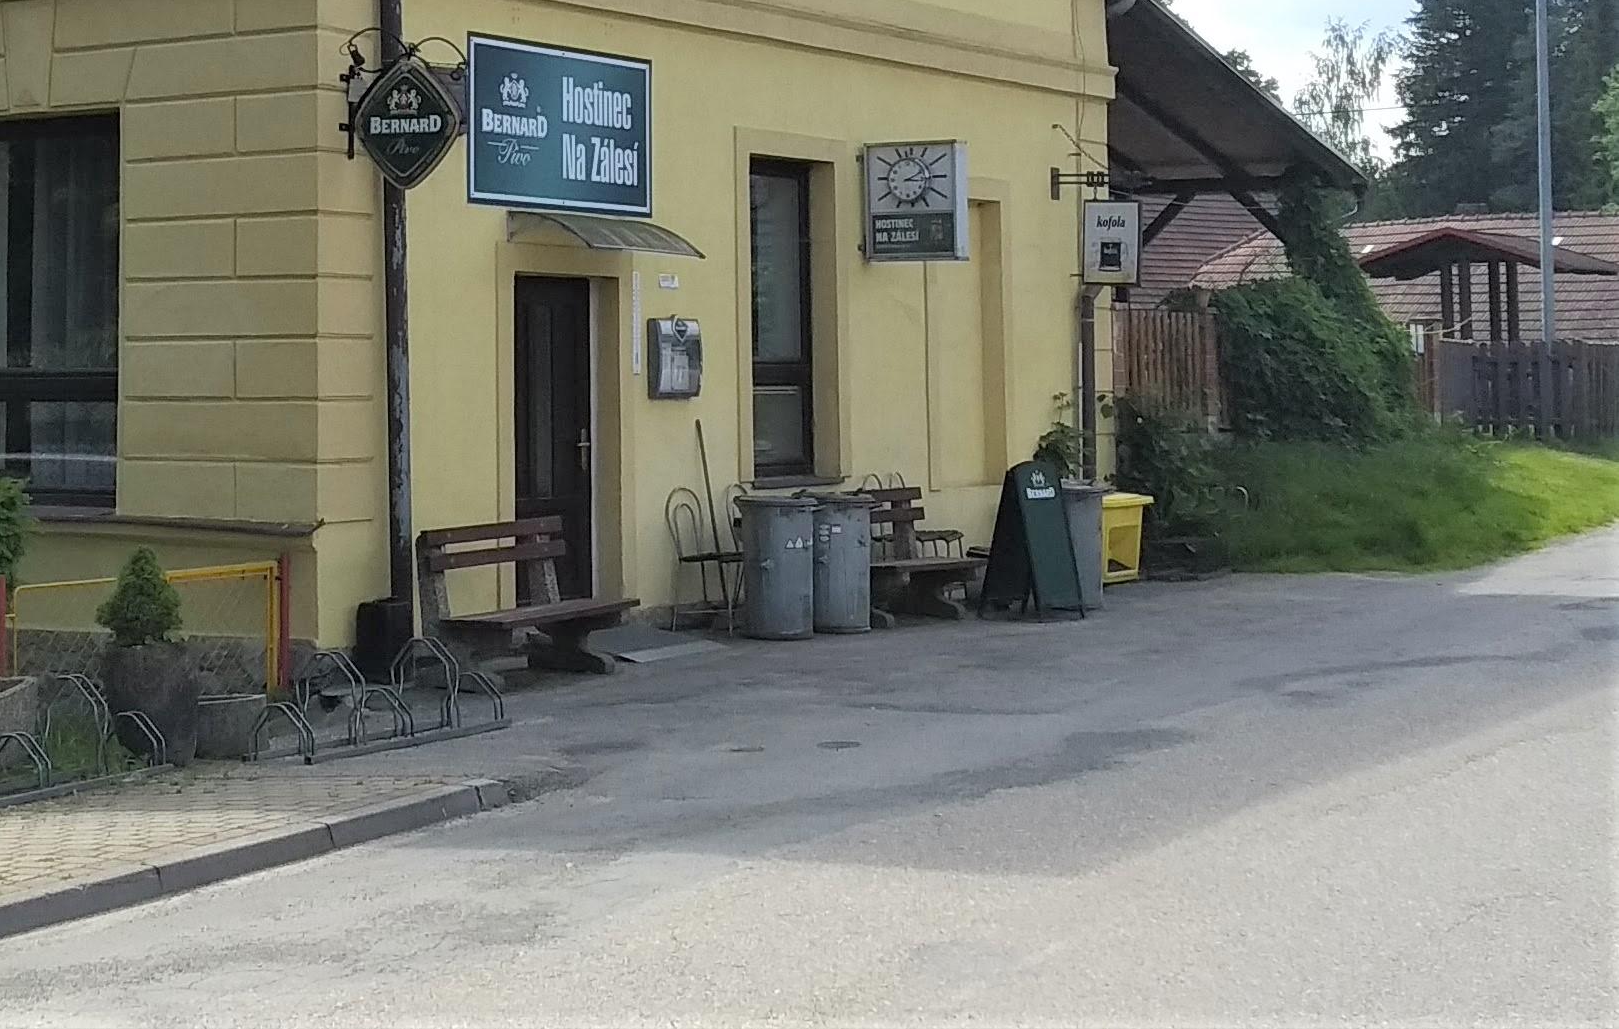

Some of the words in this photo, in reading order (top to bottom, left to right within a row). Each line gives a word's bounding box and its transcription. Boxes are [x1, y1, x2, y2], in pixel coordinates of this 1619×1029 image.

[562, 76, 632, 130] Hostinec
[370, 114, 442, 135] BERNARD
[481, 108, 548, 139] BERNARD
[497, 138, 532, 166] Pivo
[562, 133, 586, 181] Na
[591, 136, 639, 186] Zálesí
[875, 218, 914, 229] HOSTINEC
[1096, 215, 1126, 231] kofola
[875, 231, 888, 243] NA
